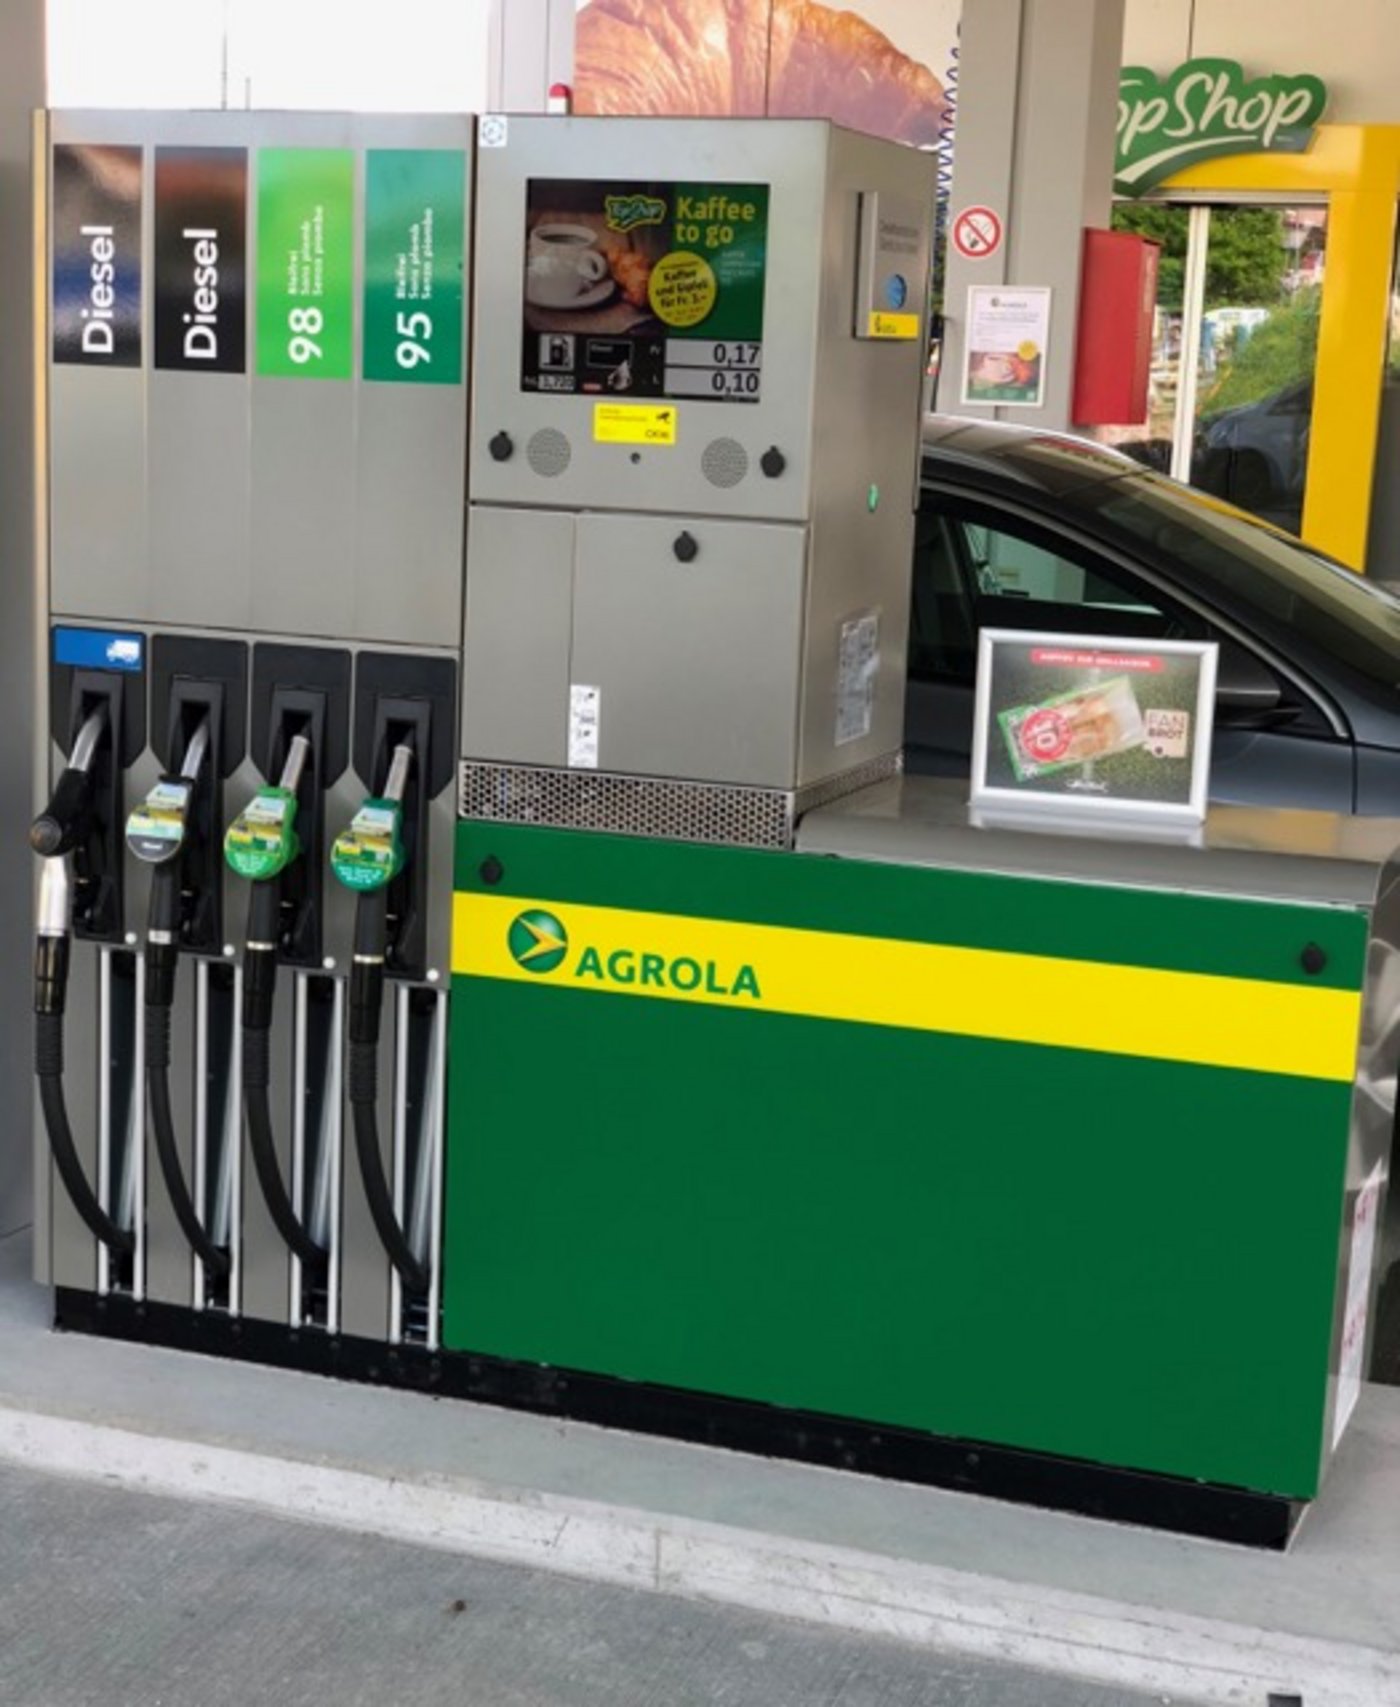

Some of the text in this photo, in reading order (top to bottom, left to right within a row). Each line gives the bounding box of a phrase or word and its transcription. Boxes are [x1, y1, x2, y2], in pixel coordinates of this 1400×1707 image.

[1117, 71, 1313, 155] pShop
[676, 223, 734, 249] to go
[677, 197, 755, 220] Kaffee
[80, 226, 114, 353] Diesel
[183, 229, 217, 359] Diesel
[288, 307, 323, 364] 98
[396, 312, 433, 369] 95
[713, 343, 760, 368] 0,17
[711, 372, 759, 396] 0,10
[575, 946, 761, 999] AGROLA
